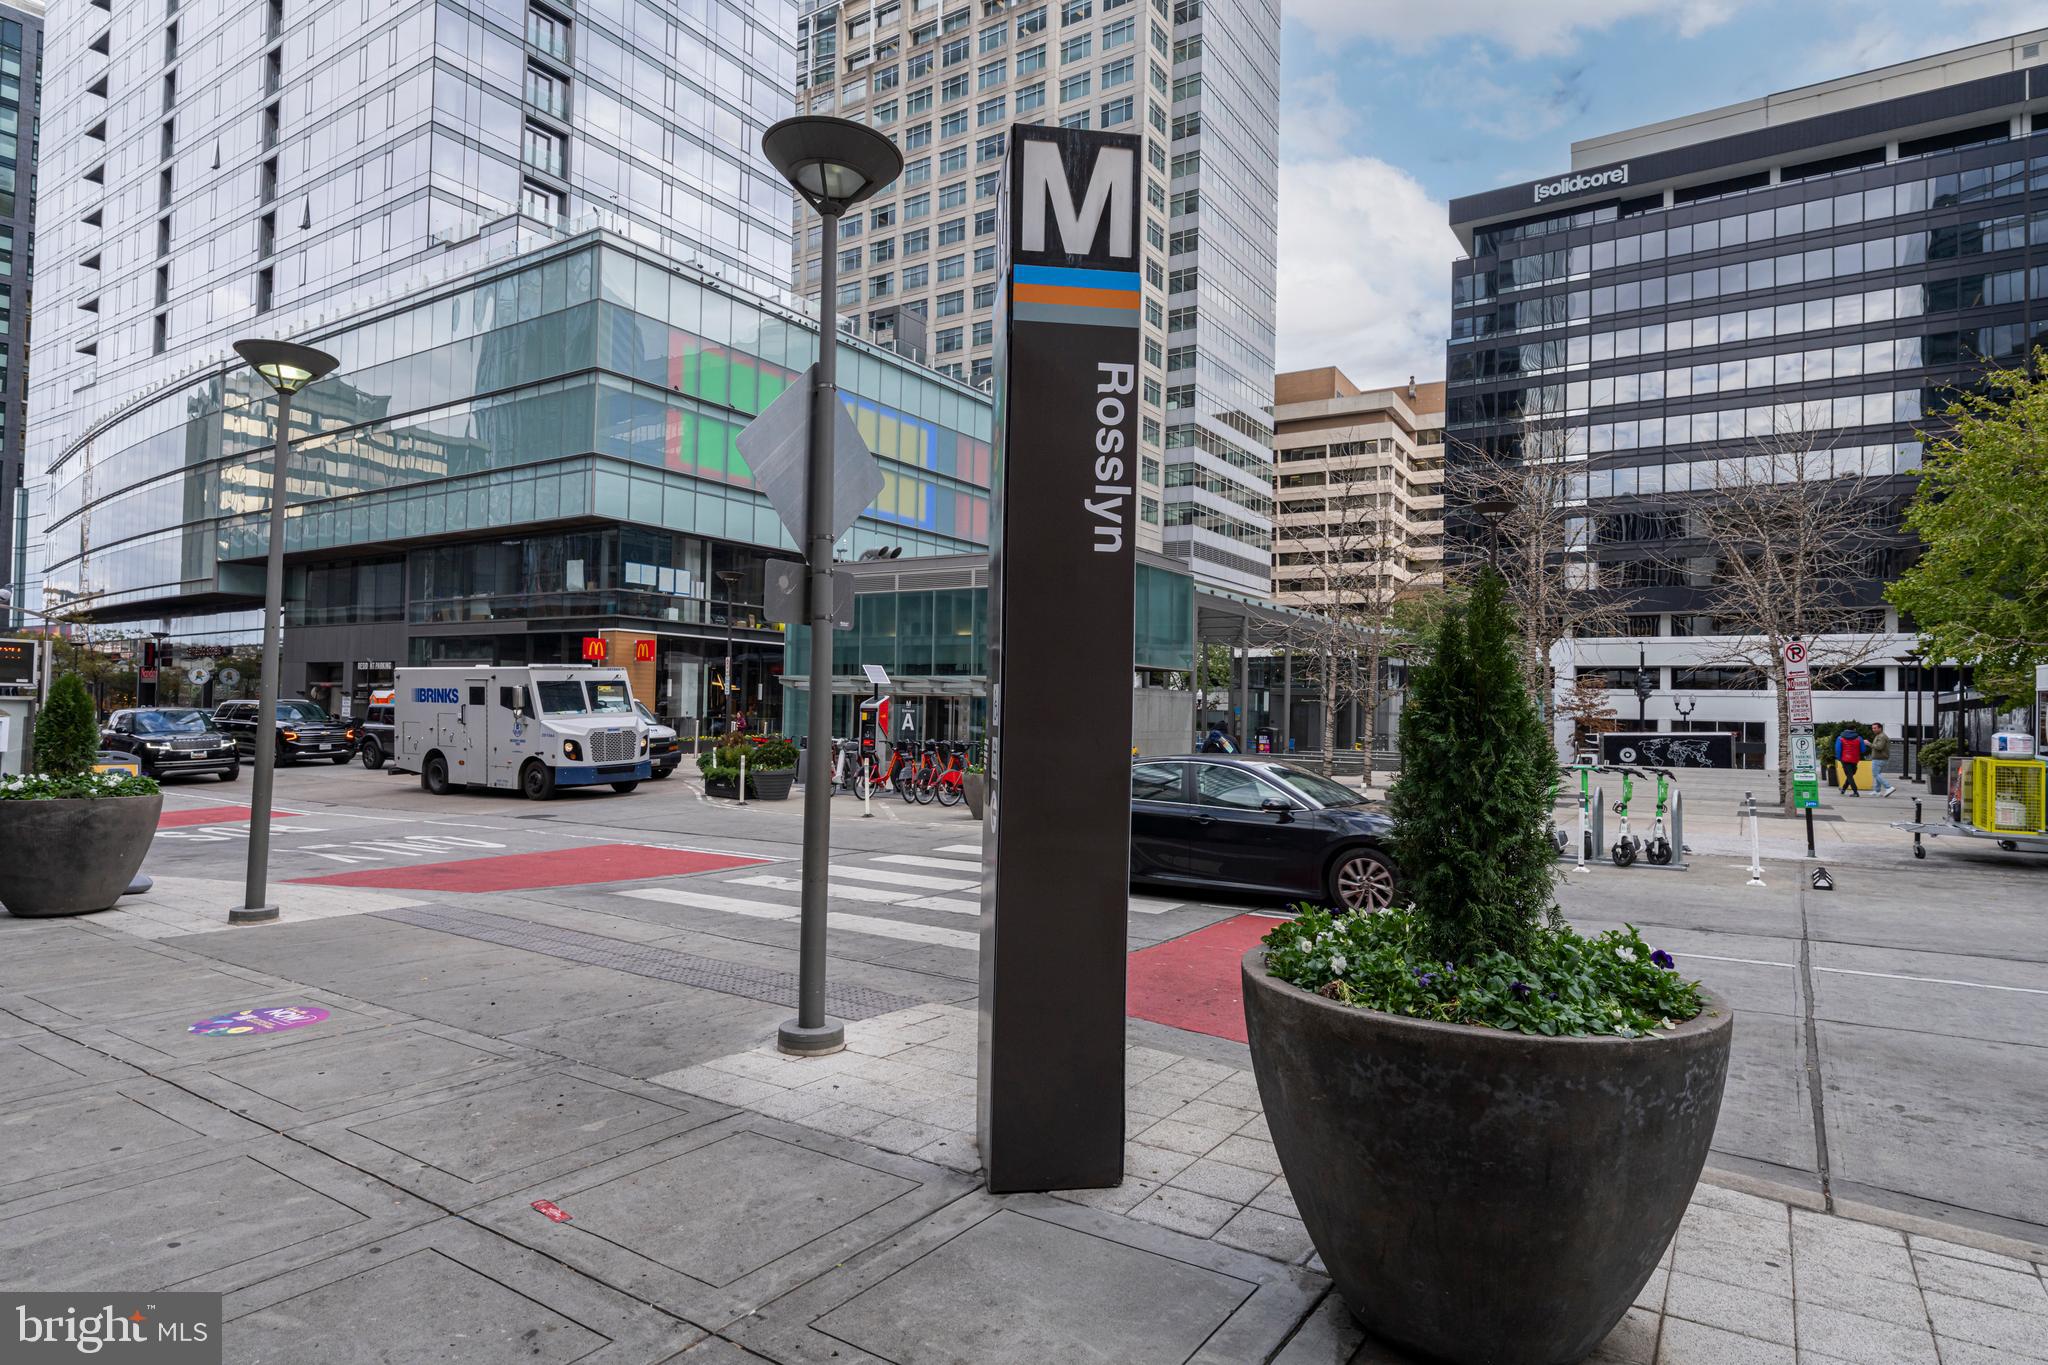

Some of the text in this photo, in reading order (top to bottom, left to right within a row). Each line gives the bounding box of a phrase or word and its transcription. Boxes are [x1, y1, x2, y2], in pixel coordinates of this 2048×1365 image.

[1534, 164, 1629, 203] [solidcore]
[1022, 140, 1133, 258] M
[1084, 362, 1135, 553] Rosslyn
[357, 662, 375, 670] RESIDNT
[418, 687, 459, 704] BRINKS
[902, 713, 914, 730] A
[273, 835, 506, 863] ONLY
